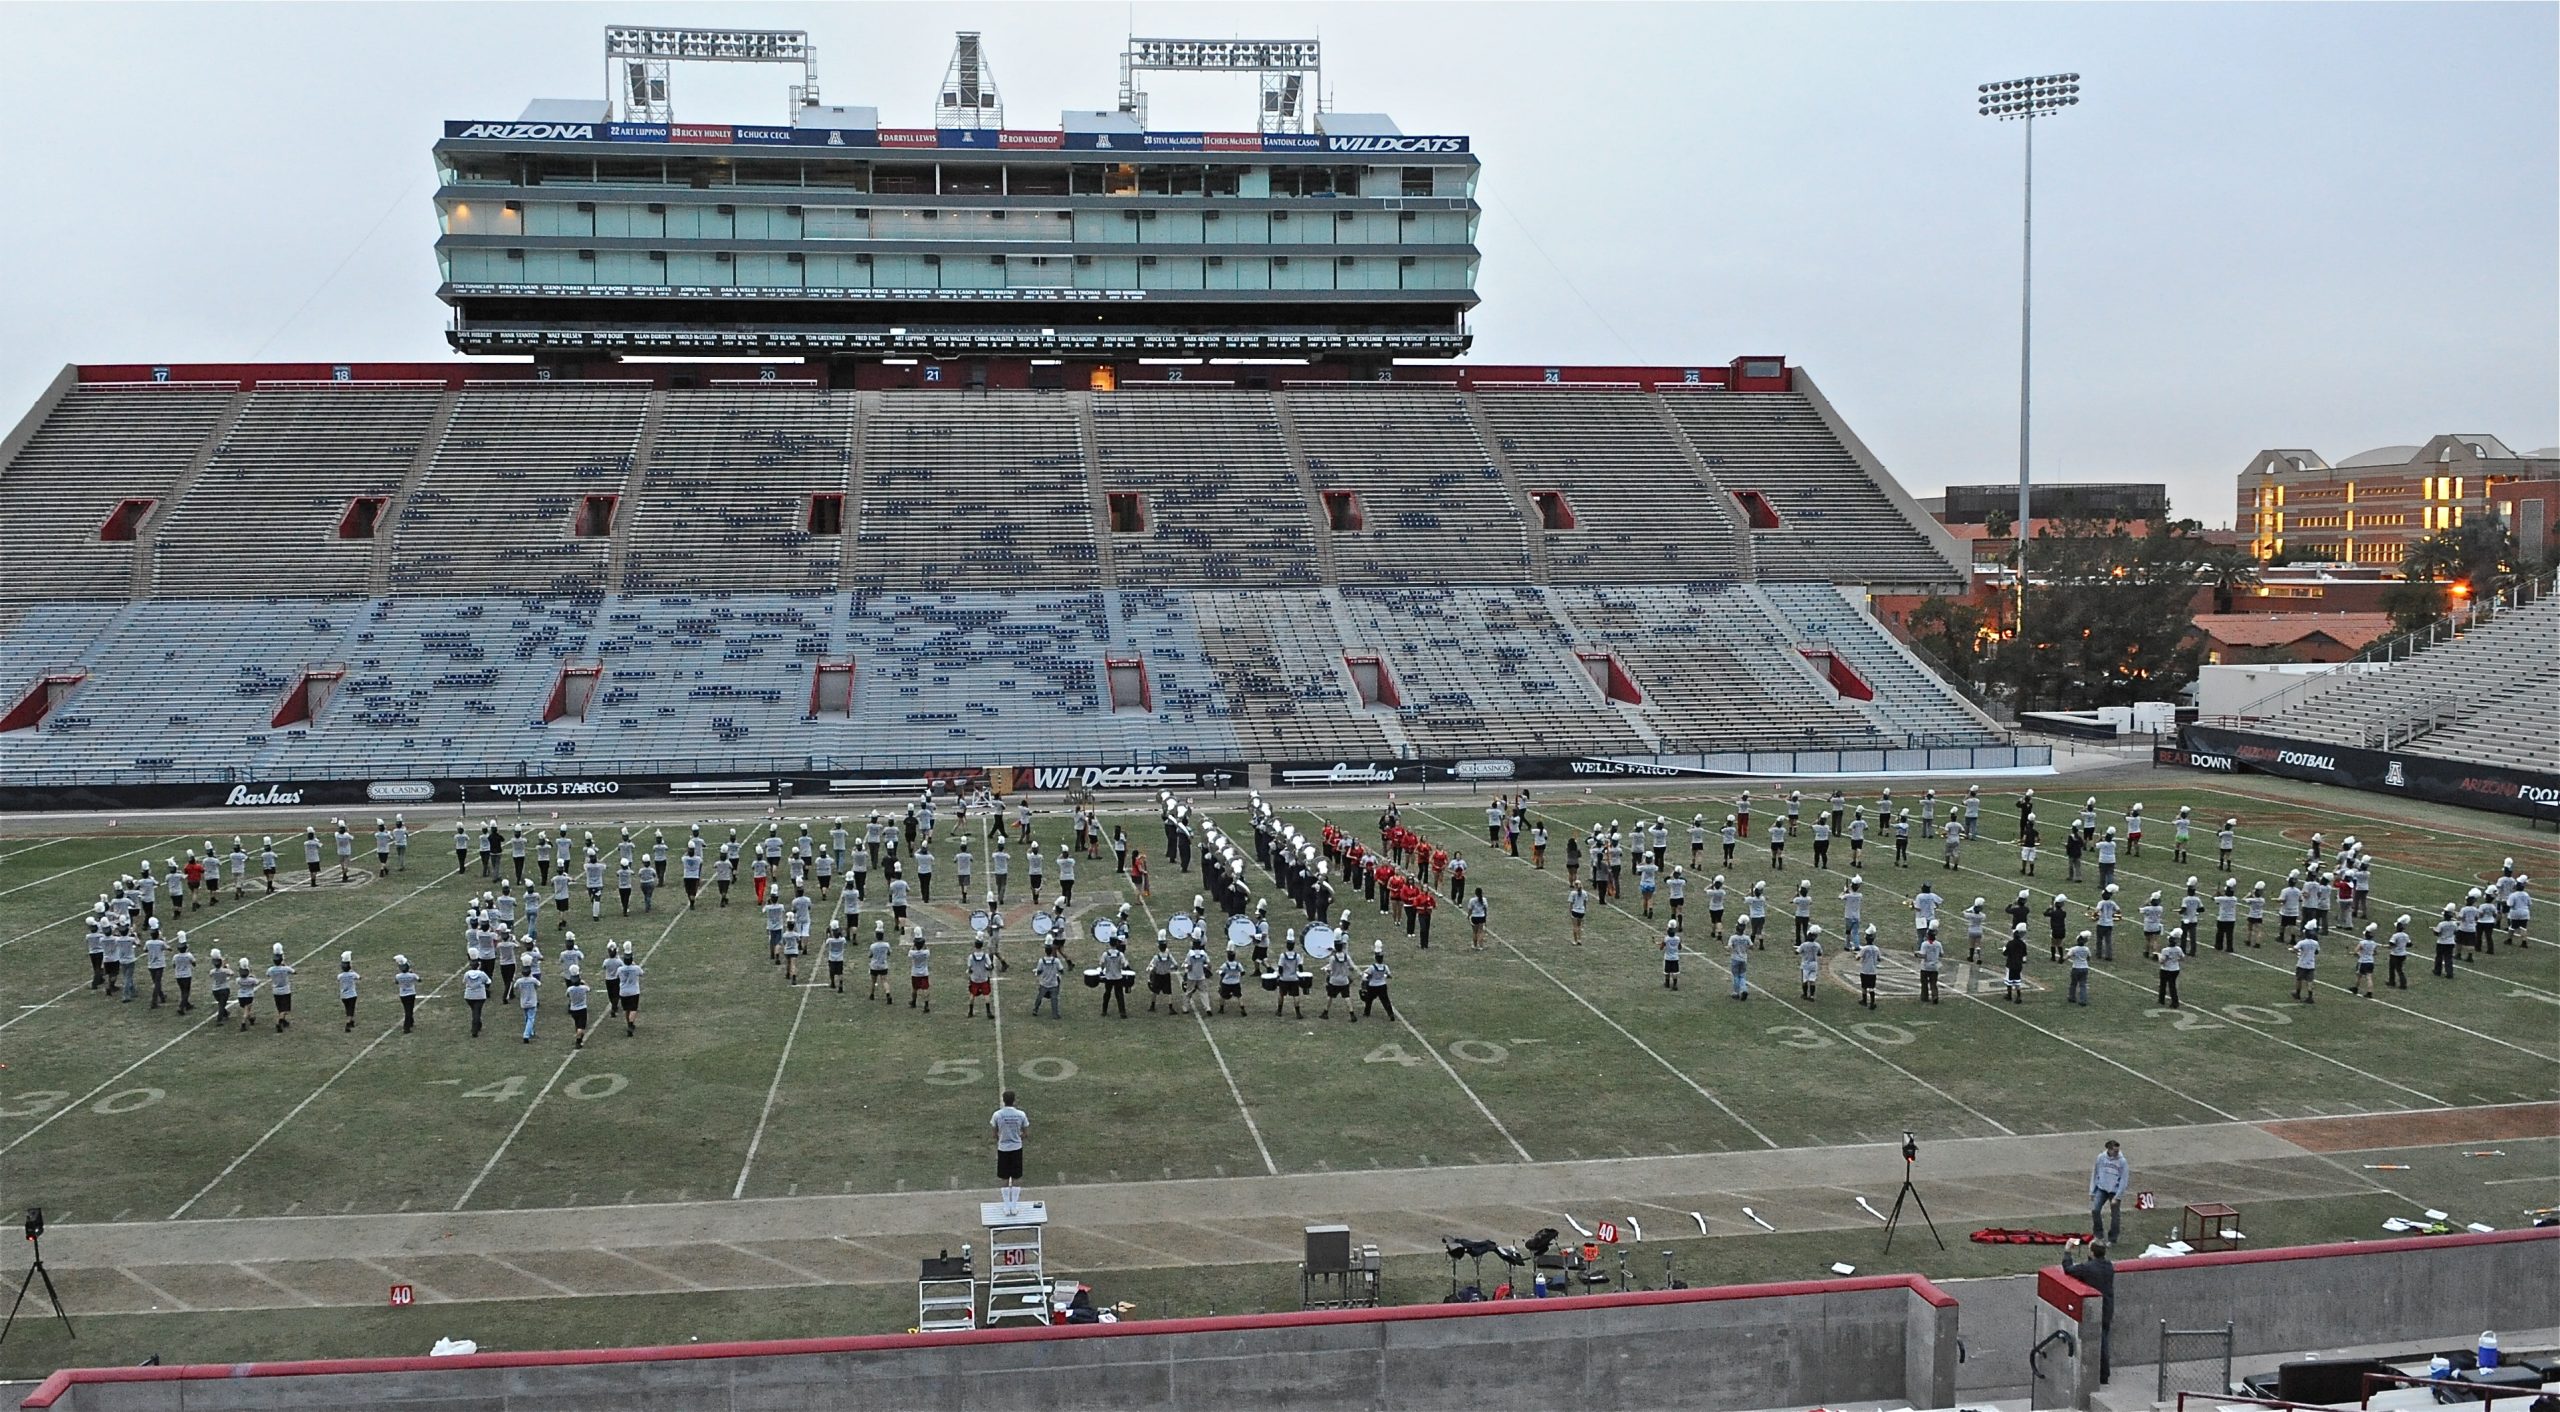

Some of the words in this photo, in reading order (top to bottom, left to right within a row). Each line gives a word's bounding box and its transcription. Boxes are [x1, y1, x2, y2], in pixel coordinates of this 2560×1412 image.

[459, 124, 593, 139] ARIZONA
[611, 126, 620, 136] 22
[620, 126, 634, 136] ART
[634, 126, 667, 136] LUPPINO
[682, 129, 702, 138] RICKY
[704, 129, 731, 138] HUNLEY
[744, 130, 769, 139] CHUCK
[770, 130, 790, 139] CECIL
[878, 133, 883, 142] 4
[884, 133, 914, 142] DARRYLL
[914, 133, 937, 142] LEWIS
[999, 134, 1008, 144] 92
[1008, 134, 1023, 144] ROB
[1024, 134, 1058, 144] WALDROP
[1144, 136, 1152, 145] 28
[1153, 136, 1168, 145] STEVE
[1169, 136, 1202, 145] McLAUGHLIN
[1204, 136, 1210, 146] 11
[1210, 136, 1228, 146] CHRIS
[1229, 136, 1262, 146] McALISTER
[1268, 137, 1296, 146] ANTOINE
[1297, 137, 1320, 146] CASON
[1328, 136, 1463, 152] WILDCATS
[156, 372, 167, 382] 17
[335, 371, 348, 380] 18
[539, 371, 550, 380] 19
[761, 371, 776, 380] 20
[926, 371, 939, 380] 21
[1169, 372, 1182, 380] 22
[1378, 372, 1391, 381] 23
[1545, 374, 1558, 383] 24
[1685, 374, 1698, 383] 25
[2191, 754, 2231, 770] DOWN
[2277, 750, 2336, 770] FOOTBALL
[1476, 764, 1510, 773] CASINOS
[1570, 762, 1624, 774] WELLS
[374, 786, 387, 794] SOL
[389, 785, 429, 794] CASINOS
[500, 784, 558, 795] WELLS
[562, 782, 619, 794] FARGO
[226, 785, 303, 805] Bashas'
[2144, 1003, 2292, 1030] 20
[1765, 1022, 1916, 1049] 30
[1364, 1040, 1509, 1066] 40
[925, 1057, 1079, 1086] 50
[462, 1073, 629, 1103] 40
[2140, 1193, 2154, 1209] 30
[1598, 1224, 1614, 1241] 40
[1006, 1249, 1023, 1265] 50
[392, 1287, 410, 1304] 40
